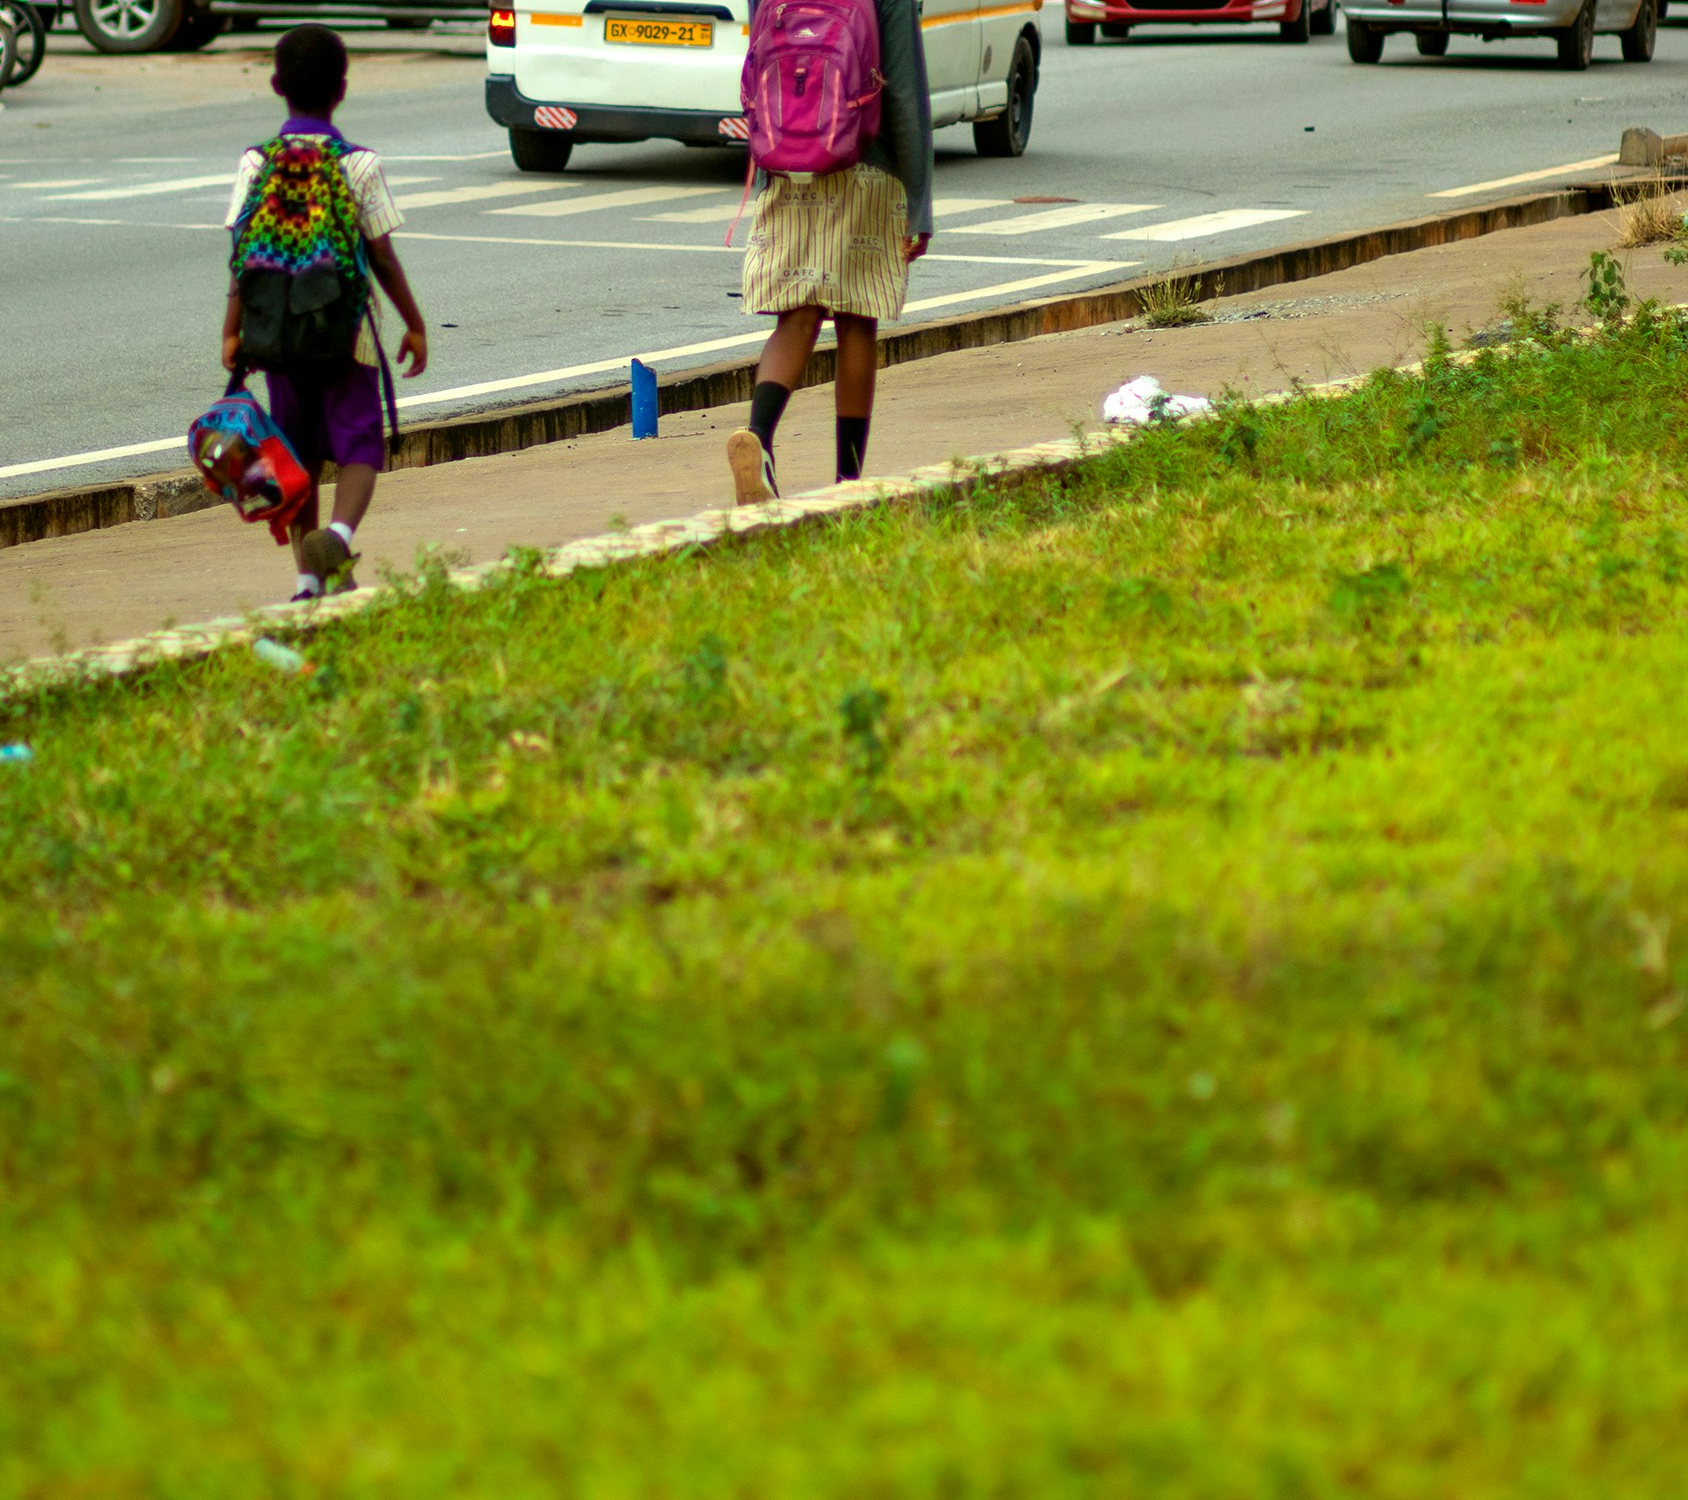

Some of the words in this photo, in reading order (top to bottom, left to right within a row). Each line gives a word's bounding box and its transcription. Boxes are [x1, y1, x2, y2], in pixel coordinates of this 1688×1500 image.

[611, 23, 628, 37] GX
[636, 25, 694, 41] 9029-21
[784, 192, 818, 201] GAEC
[853, 237, 878, 246] GAEC
[783, 269, 815, 278] GAEC
